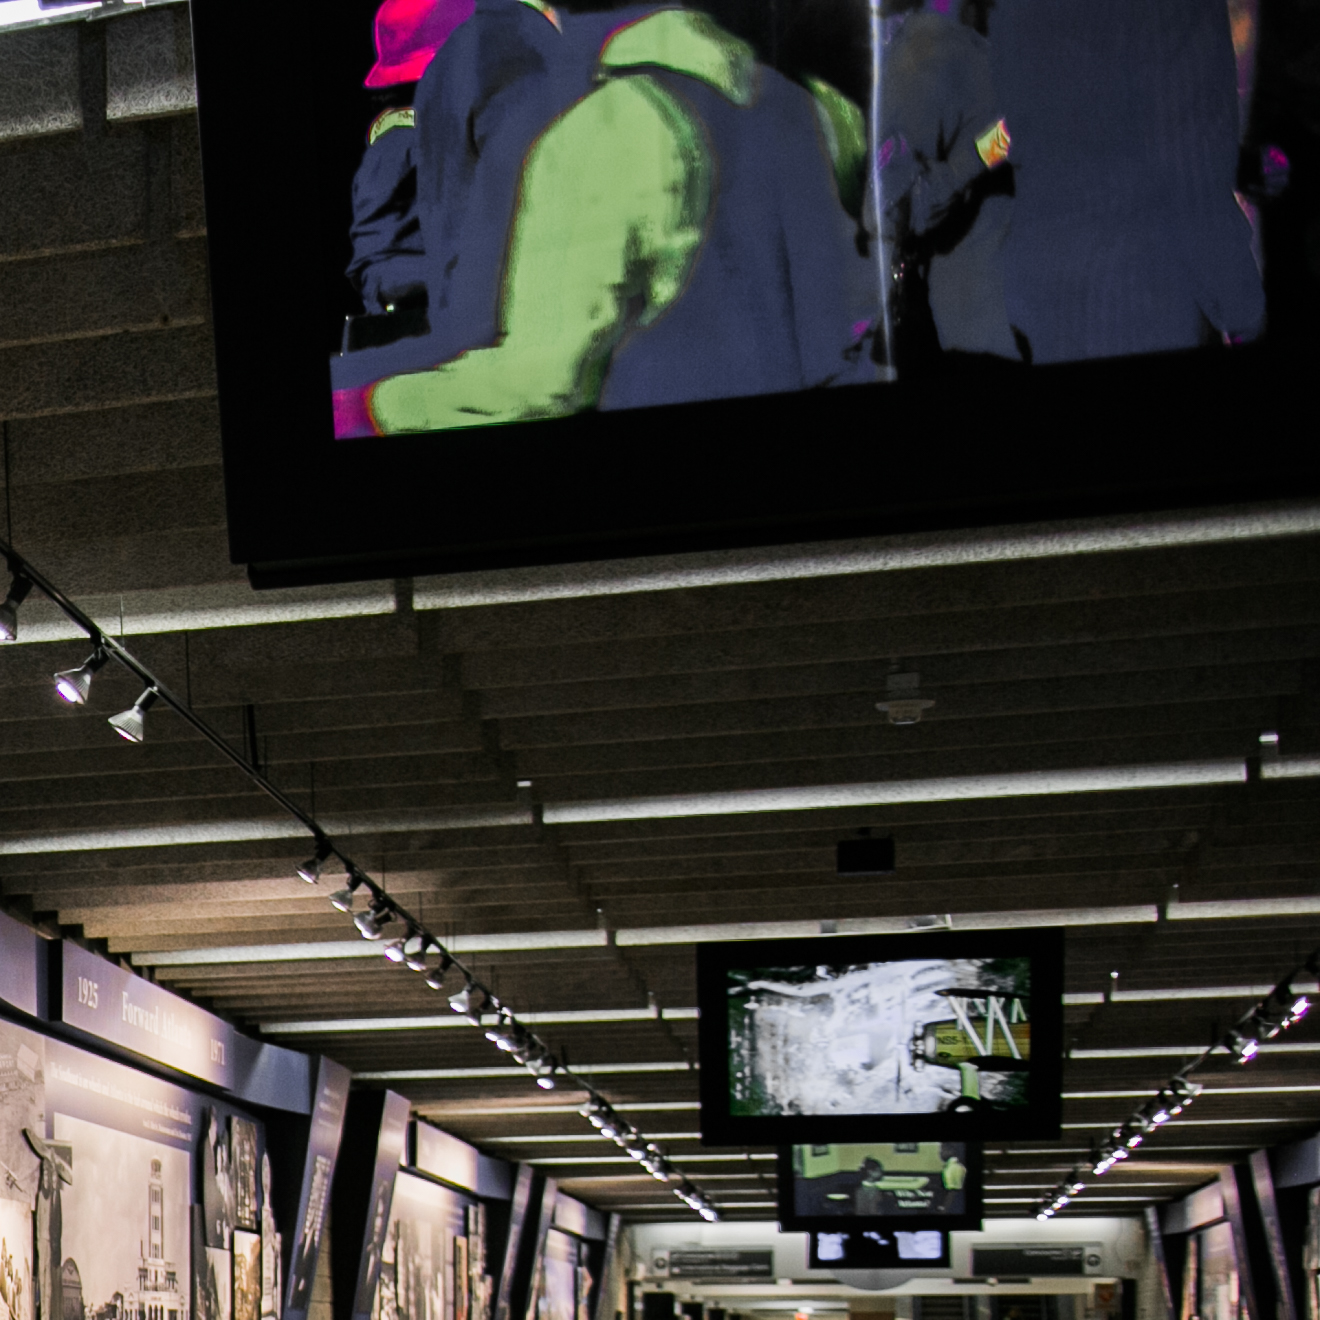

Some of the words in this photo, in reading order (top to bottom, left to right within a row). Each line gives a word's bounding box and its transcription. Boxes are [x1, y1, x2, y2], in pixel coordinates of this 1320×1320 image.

[77, 976, 99, 1010] 1925
[122, 991, 159, 1035] Forward
[210, 1038, 226, 1066] 1971
